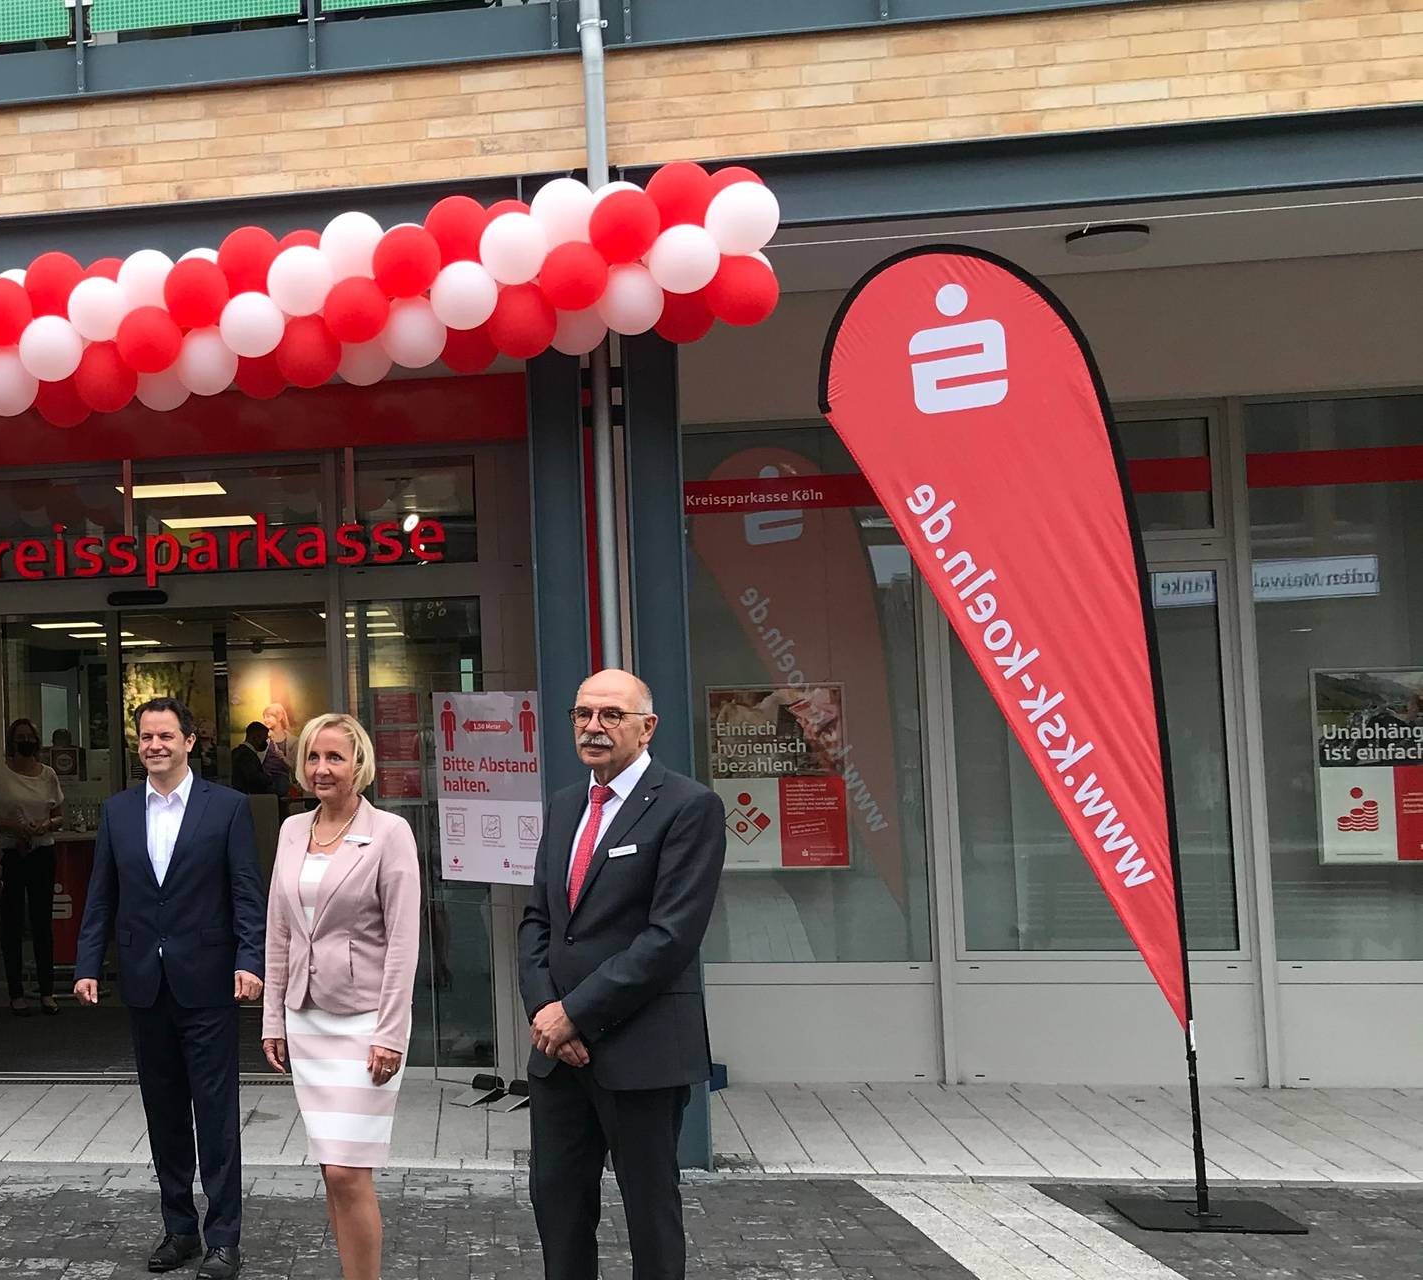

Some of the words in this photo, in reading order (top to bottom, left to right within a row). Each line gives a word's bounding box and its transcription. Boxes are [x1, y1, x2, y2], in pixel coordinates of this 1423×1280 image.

[686, 491, 789, 507] Kreissparkasse
[792, 488, 824, 502] Köln
[717, 721, 777, 737] Einfach
[717, 739, 807, 757] hygienisch
[1324, 743, 1352, 761] ist
[443, 756, 474, 772] Bitte
[479, 756, 537, 773] Abstand
[719, 757, 798, 773] bezahlen.
[443, 775, 490, 792] halten.
